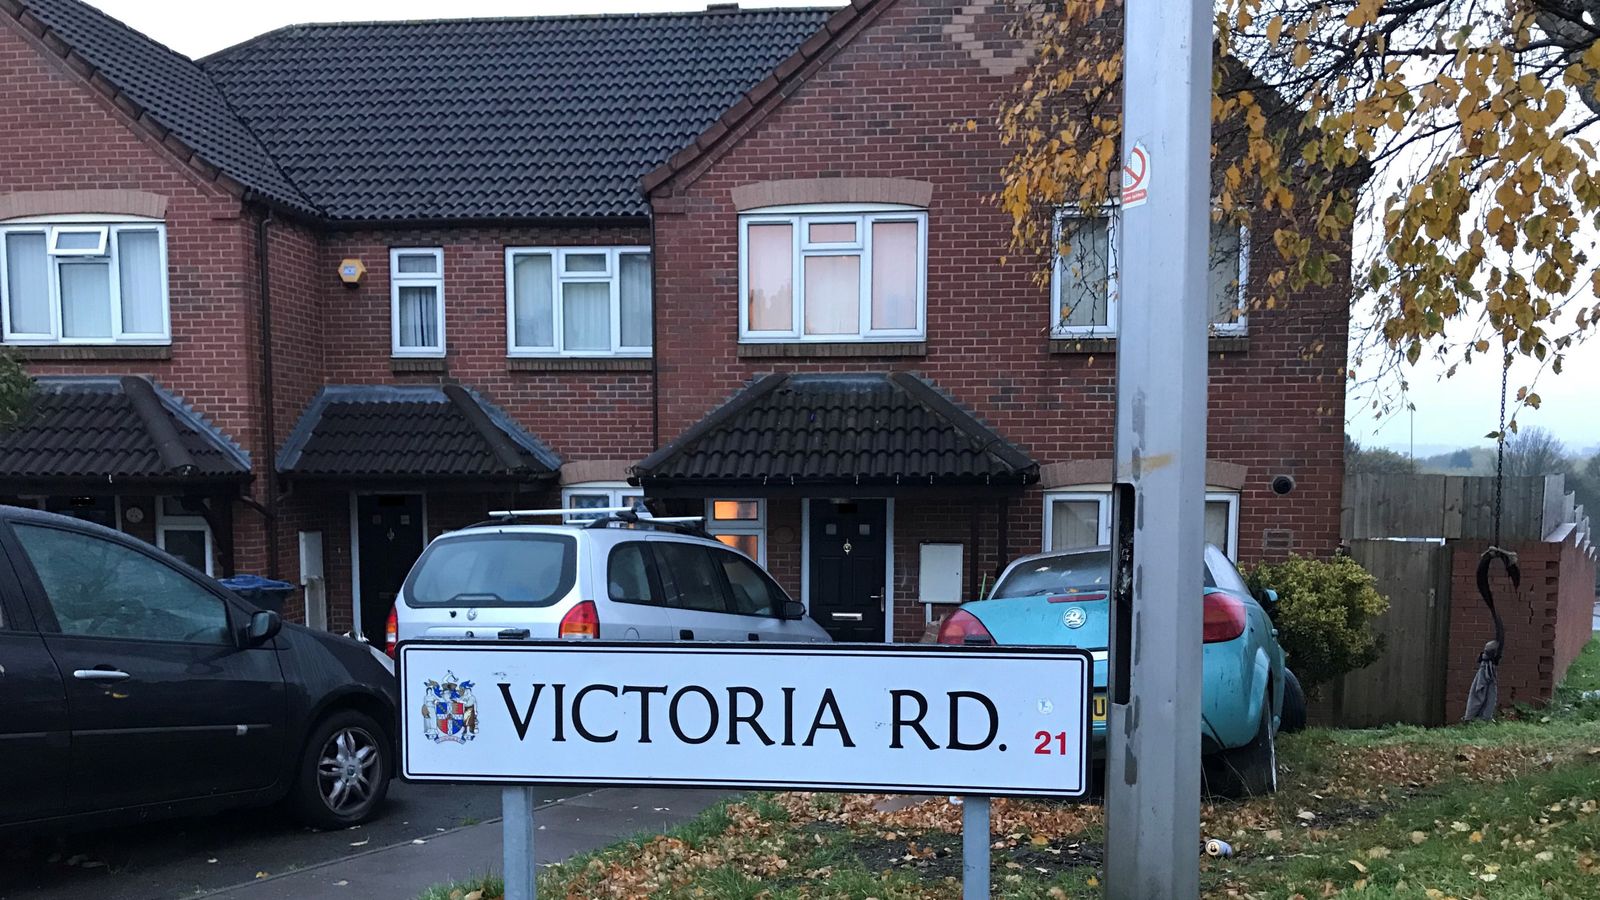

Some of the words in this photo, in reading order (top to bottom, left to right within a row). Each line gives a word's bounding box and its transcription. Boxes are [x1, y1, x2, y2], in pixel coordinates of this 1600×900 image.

[496, 683, 856, 748] VICTORIA
[889, 689, 1007, 751] RD.
[1034, 731, 1066, 755] 21
